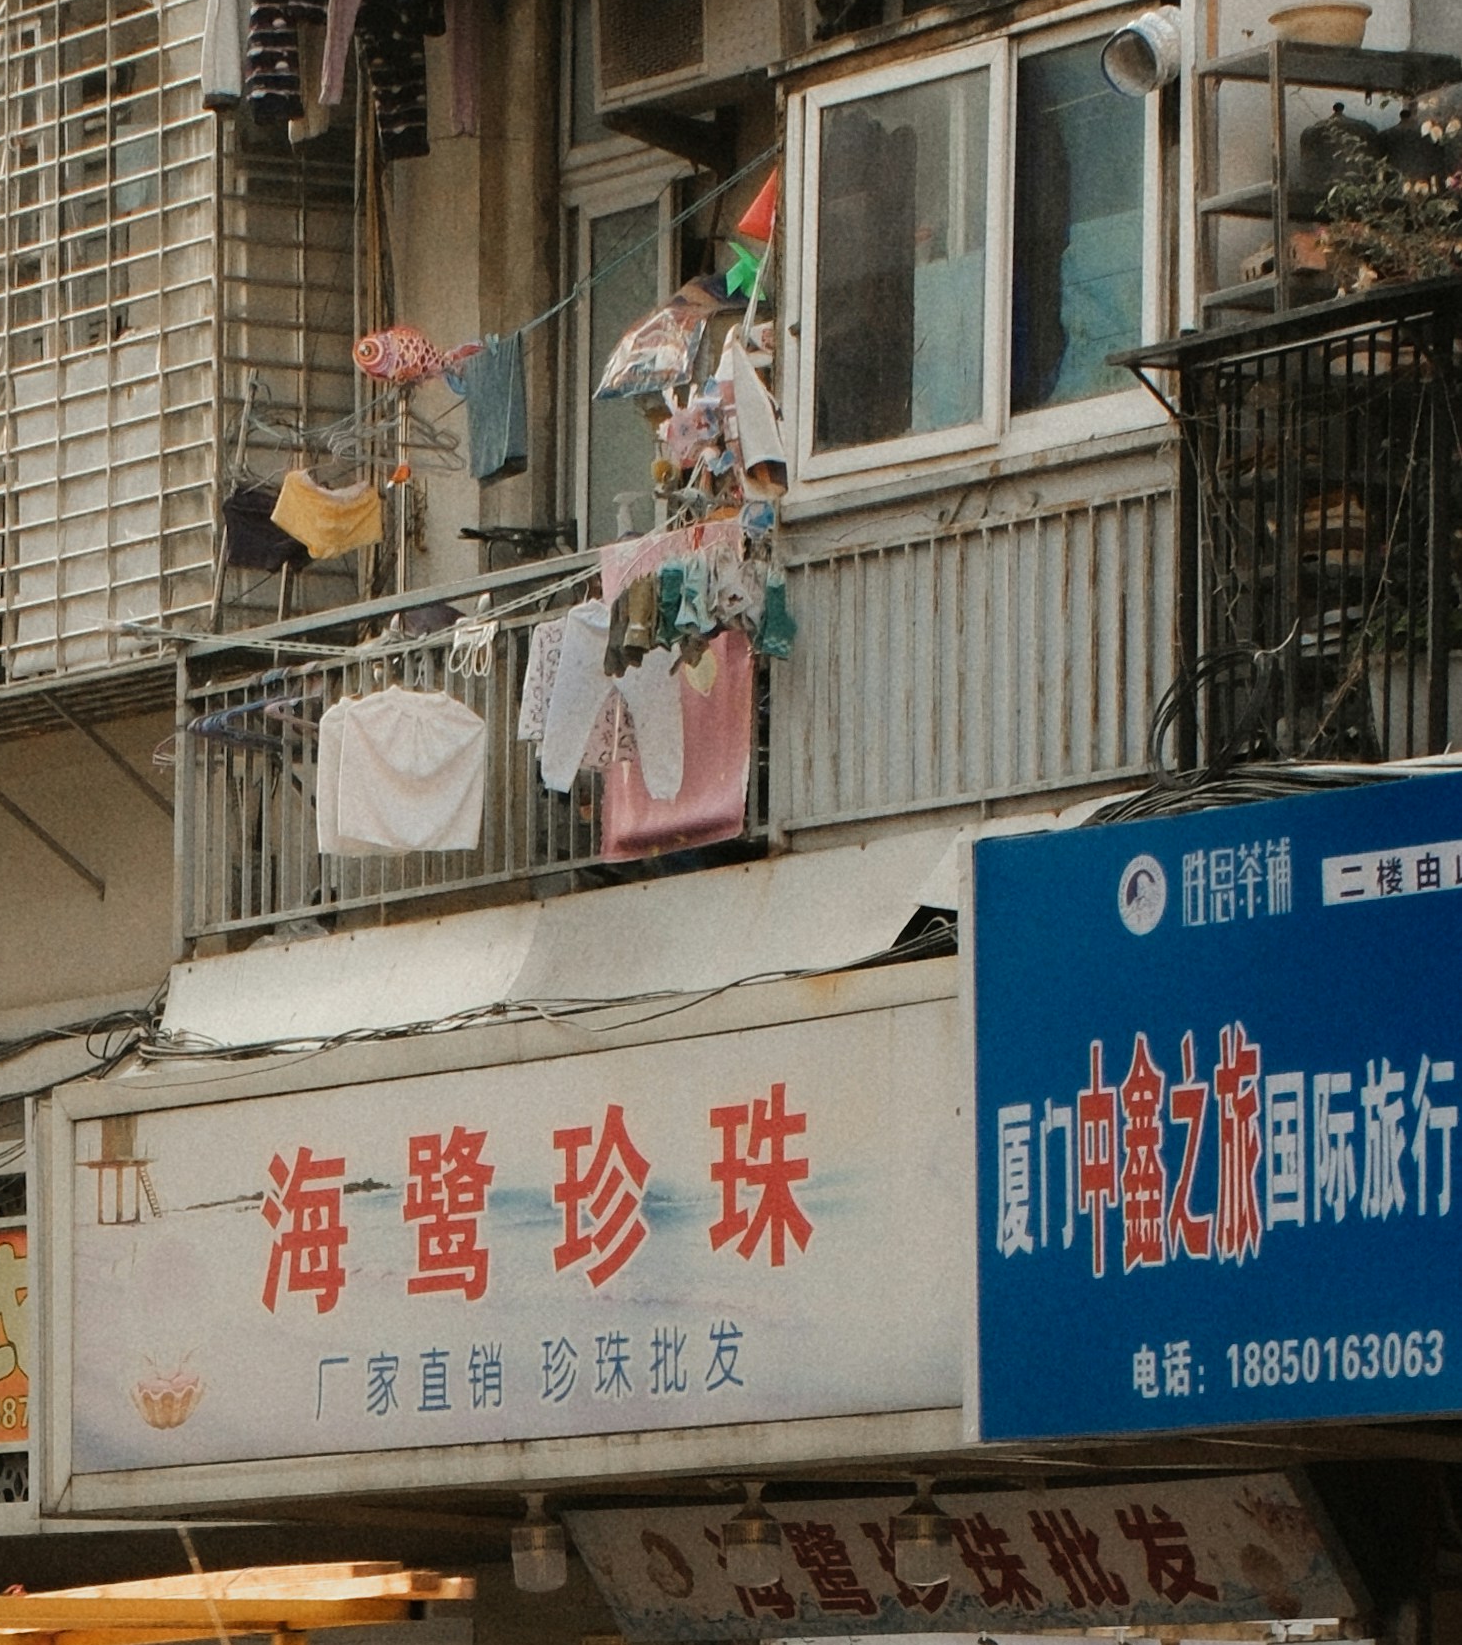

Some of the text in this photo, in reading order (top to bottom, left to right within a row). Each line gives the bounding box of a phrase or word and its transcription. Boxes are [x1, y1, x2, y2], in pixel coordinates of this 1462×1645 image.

[1340, 852, 1462, 898] 二楼由
[260, 1082, 815, 1315] 海鹭珍珠
[317, 1318, 747, 1421] 厂家直销 珍珠批发
